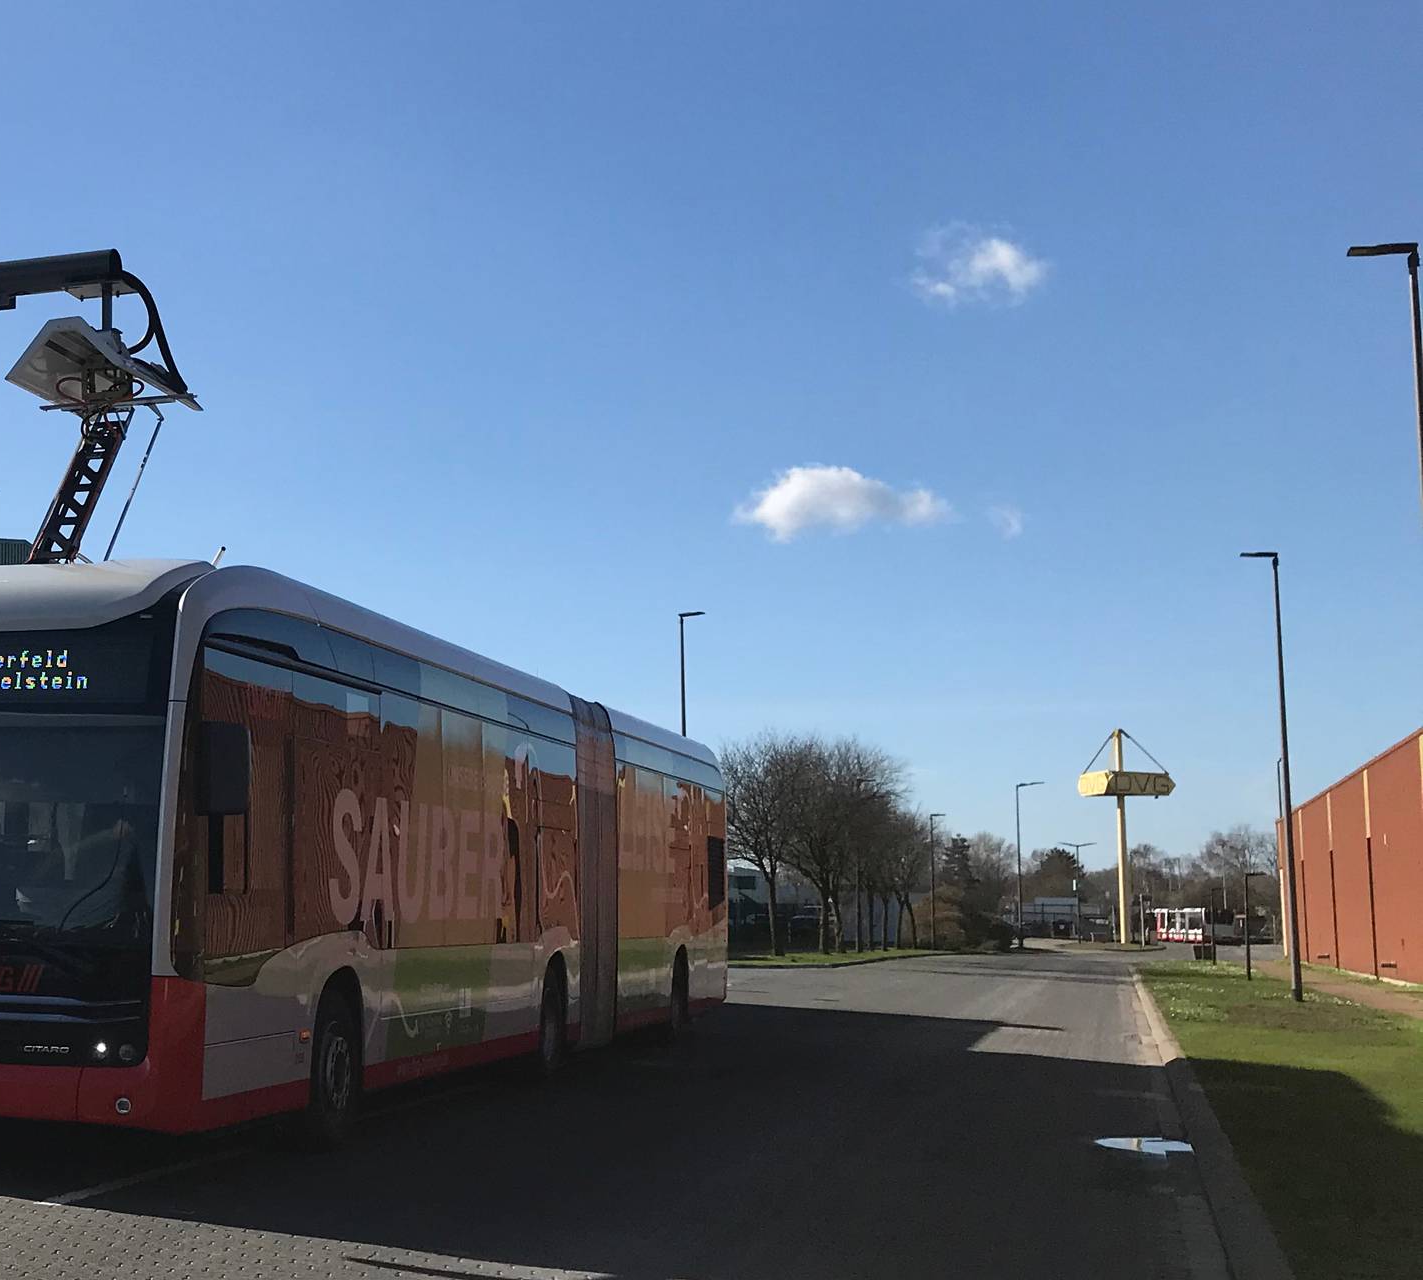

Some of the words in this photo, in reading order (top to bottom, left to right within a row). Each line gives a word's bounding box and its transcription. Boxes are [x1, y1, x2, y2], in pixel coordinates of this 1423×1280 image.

[1116, 774, 1170, 793] DVG
[329, 788, 505, 926] SAUBER
[24, 1045, 70, 1054] CITARO
